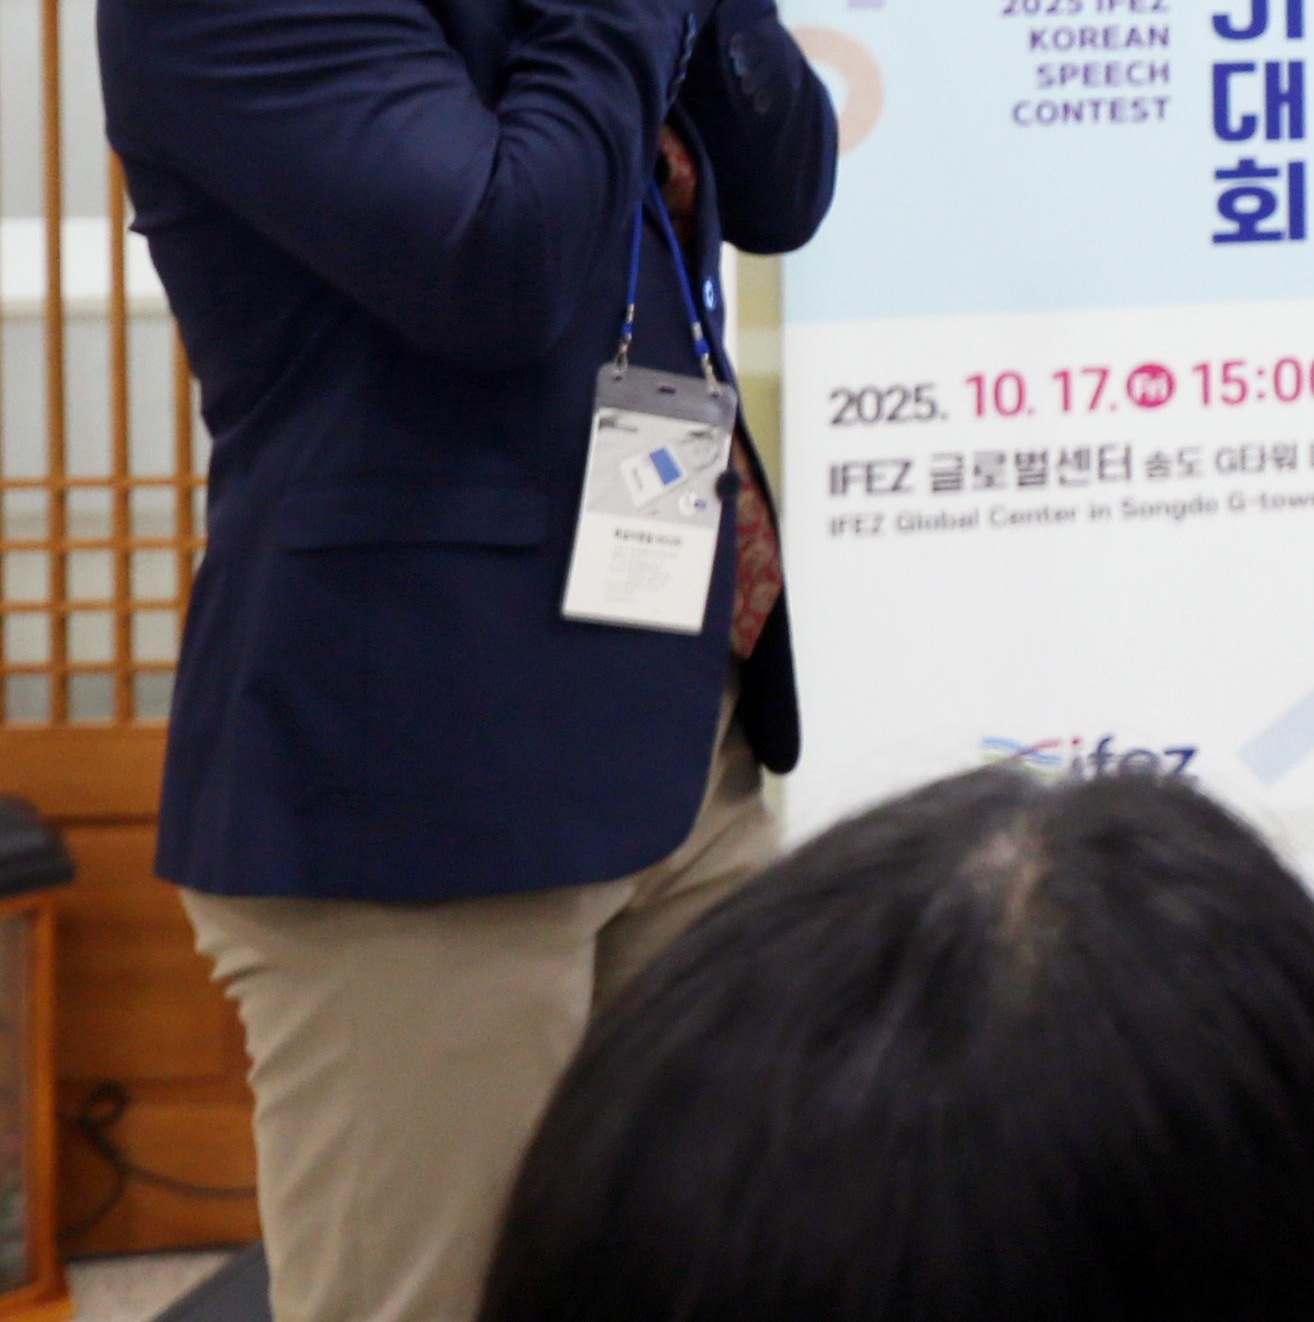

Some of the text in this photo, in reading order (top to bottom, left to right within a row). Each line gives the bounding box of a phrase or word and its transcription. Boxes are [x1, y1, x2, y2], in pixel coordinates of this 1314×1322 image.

[1029, 25, 1169, 51] KOREAN
[1036, 61, 1170, 89] SPEECH
[1012, 96, 1169, 126] CONTEST
[829, 384, 947, 427] 2025.
[966, 371, 1033, 418] 10.
[1052, 367, 1116, 413] 17.
[829, 459, 913, 496] IFEZ
[929, 444, 1132, 495] 글로벌센터
[1144, 448, 1205, 482] 송도
[1214, 443, 1298, 474] G타워
[828, 514, 884, 537] IFEZ
[894, 509, 979, 534] Global
[987, 505, 1077, 527] Center
[1090, 501, 1111, 521] in
[1120, 495, 1218, 523] Songdo
